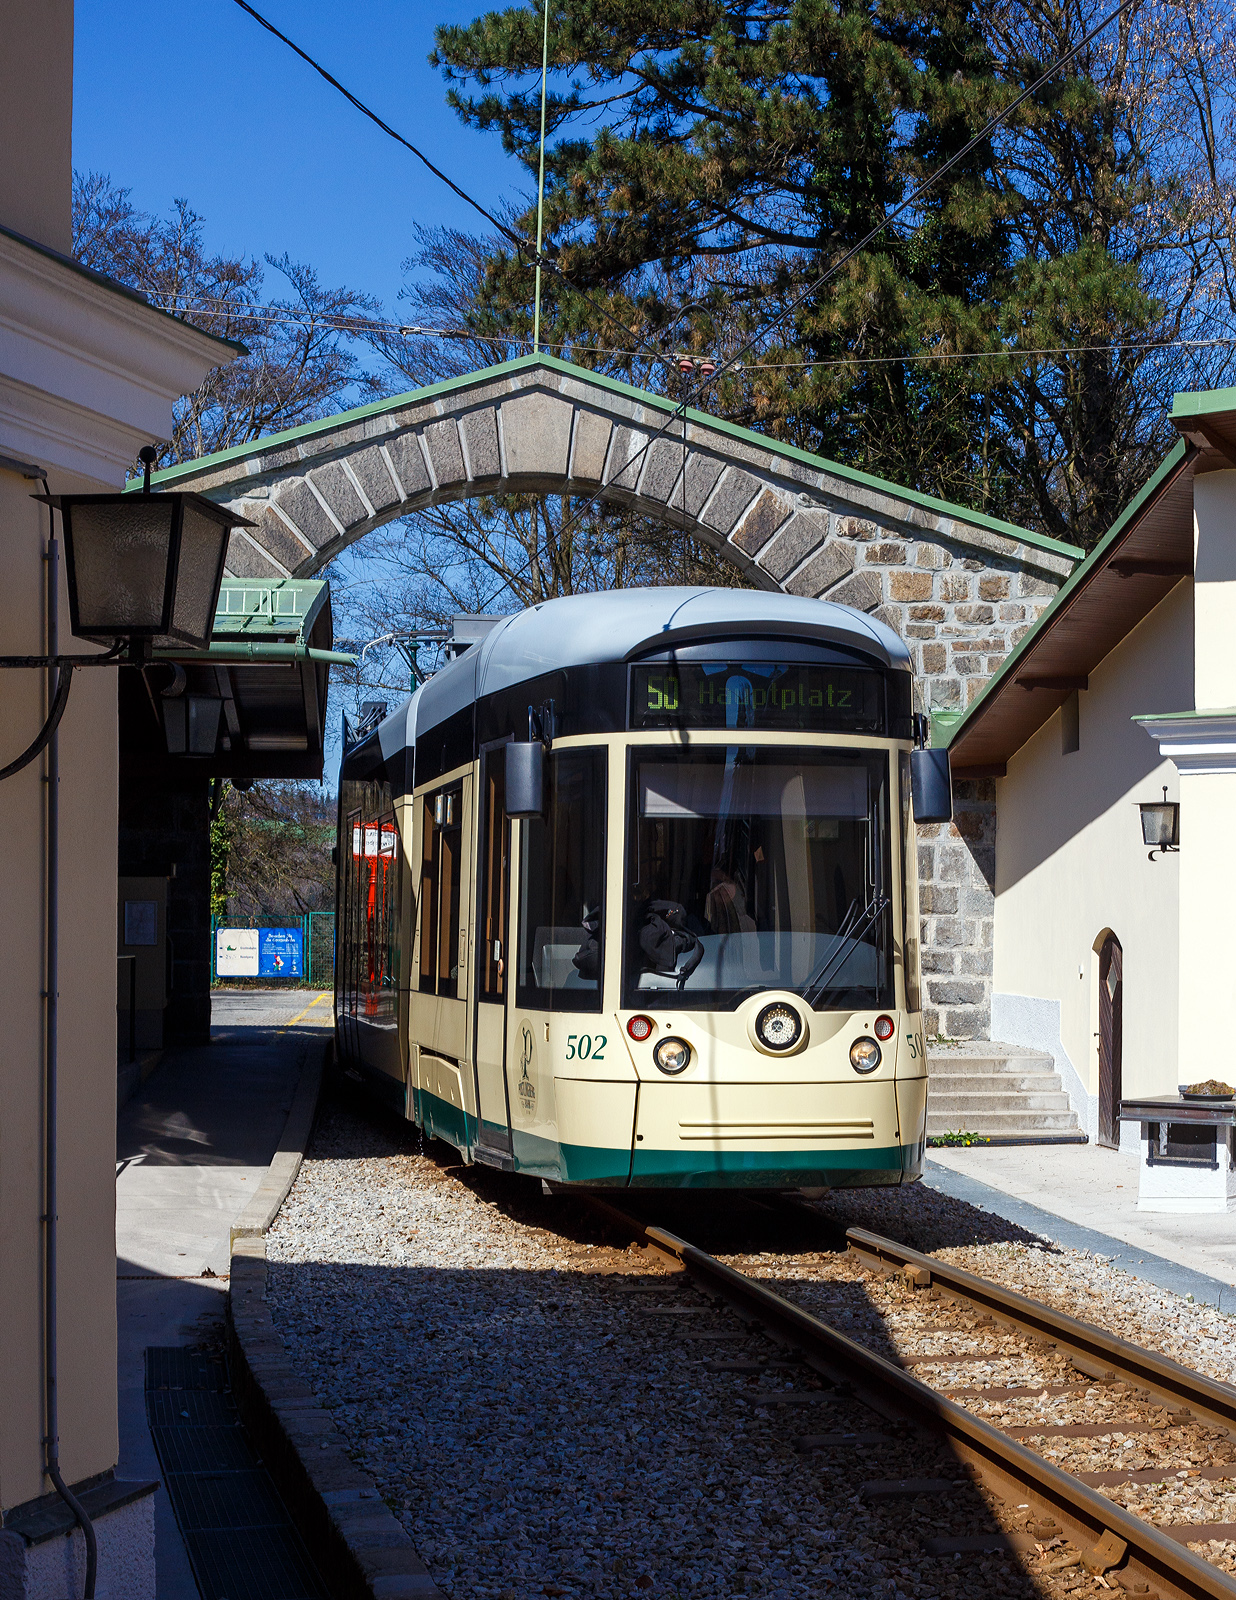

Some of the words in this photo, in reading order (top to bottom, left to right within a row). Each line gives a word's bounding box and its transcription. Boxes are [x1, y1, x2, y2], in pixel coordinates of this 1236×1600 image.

[648, 676, 678, 709] 50
[700, 681, 852, 710] Hauptplatz
[565, 1034, 608, 1060] 502
[906, 1032, 924, 1059] 50
